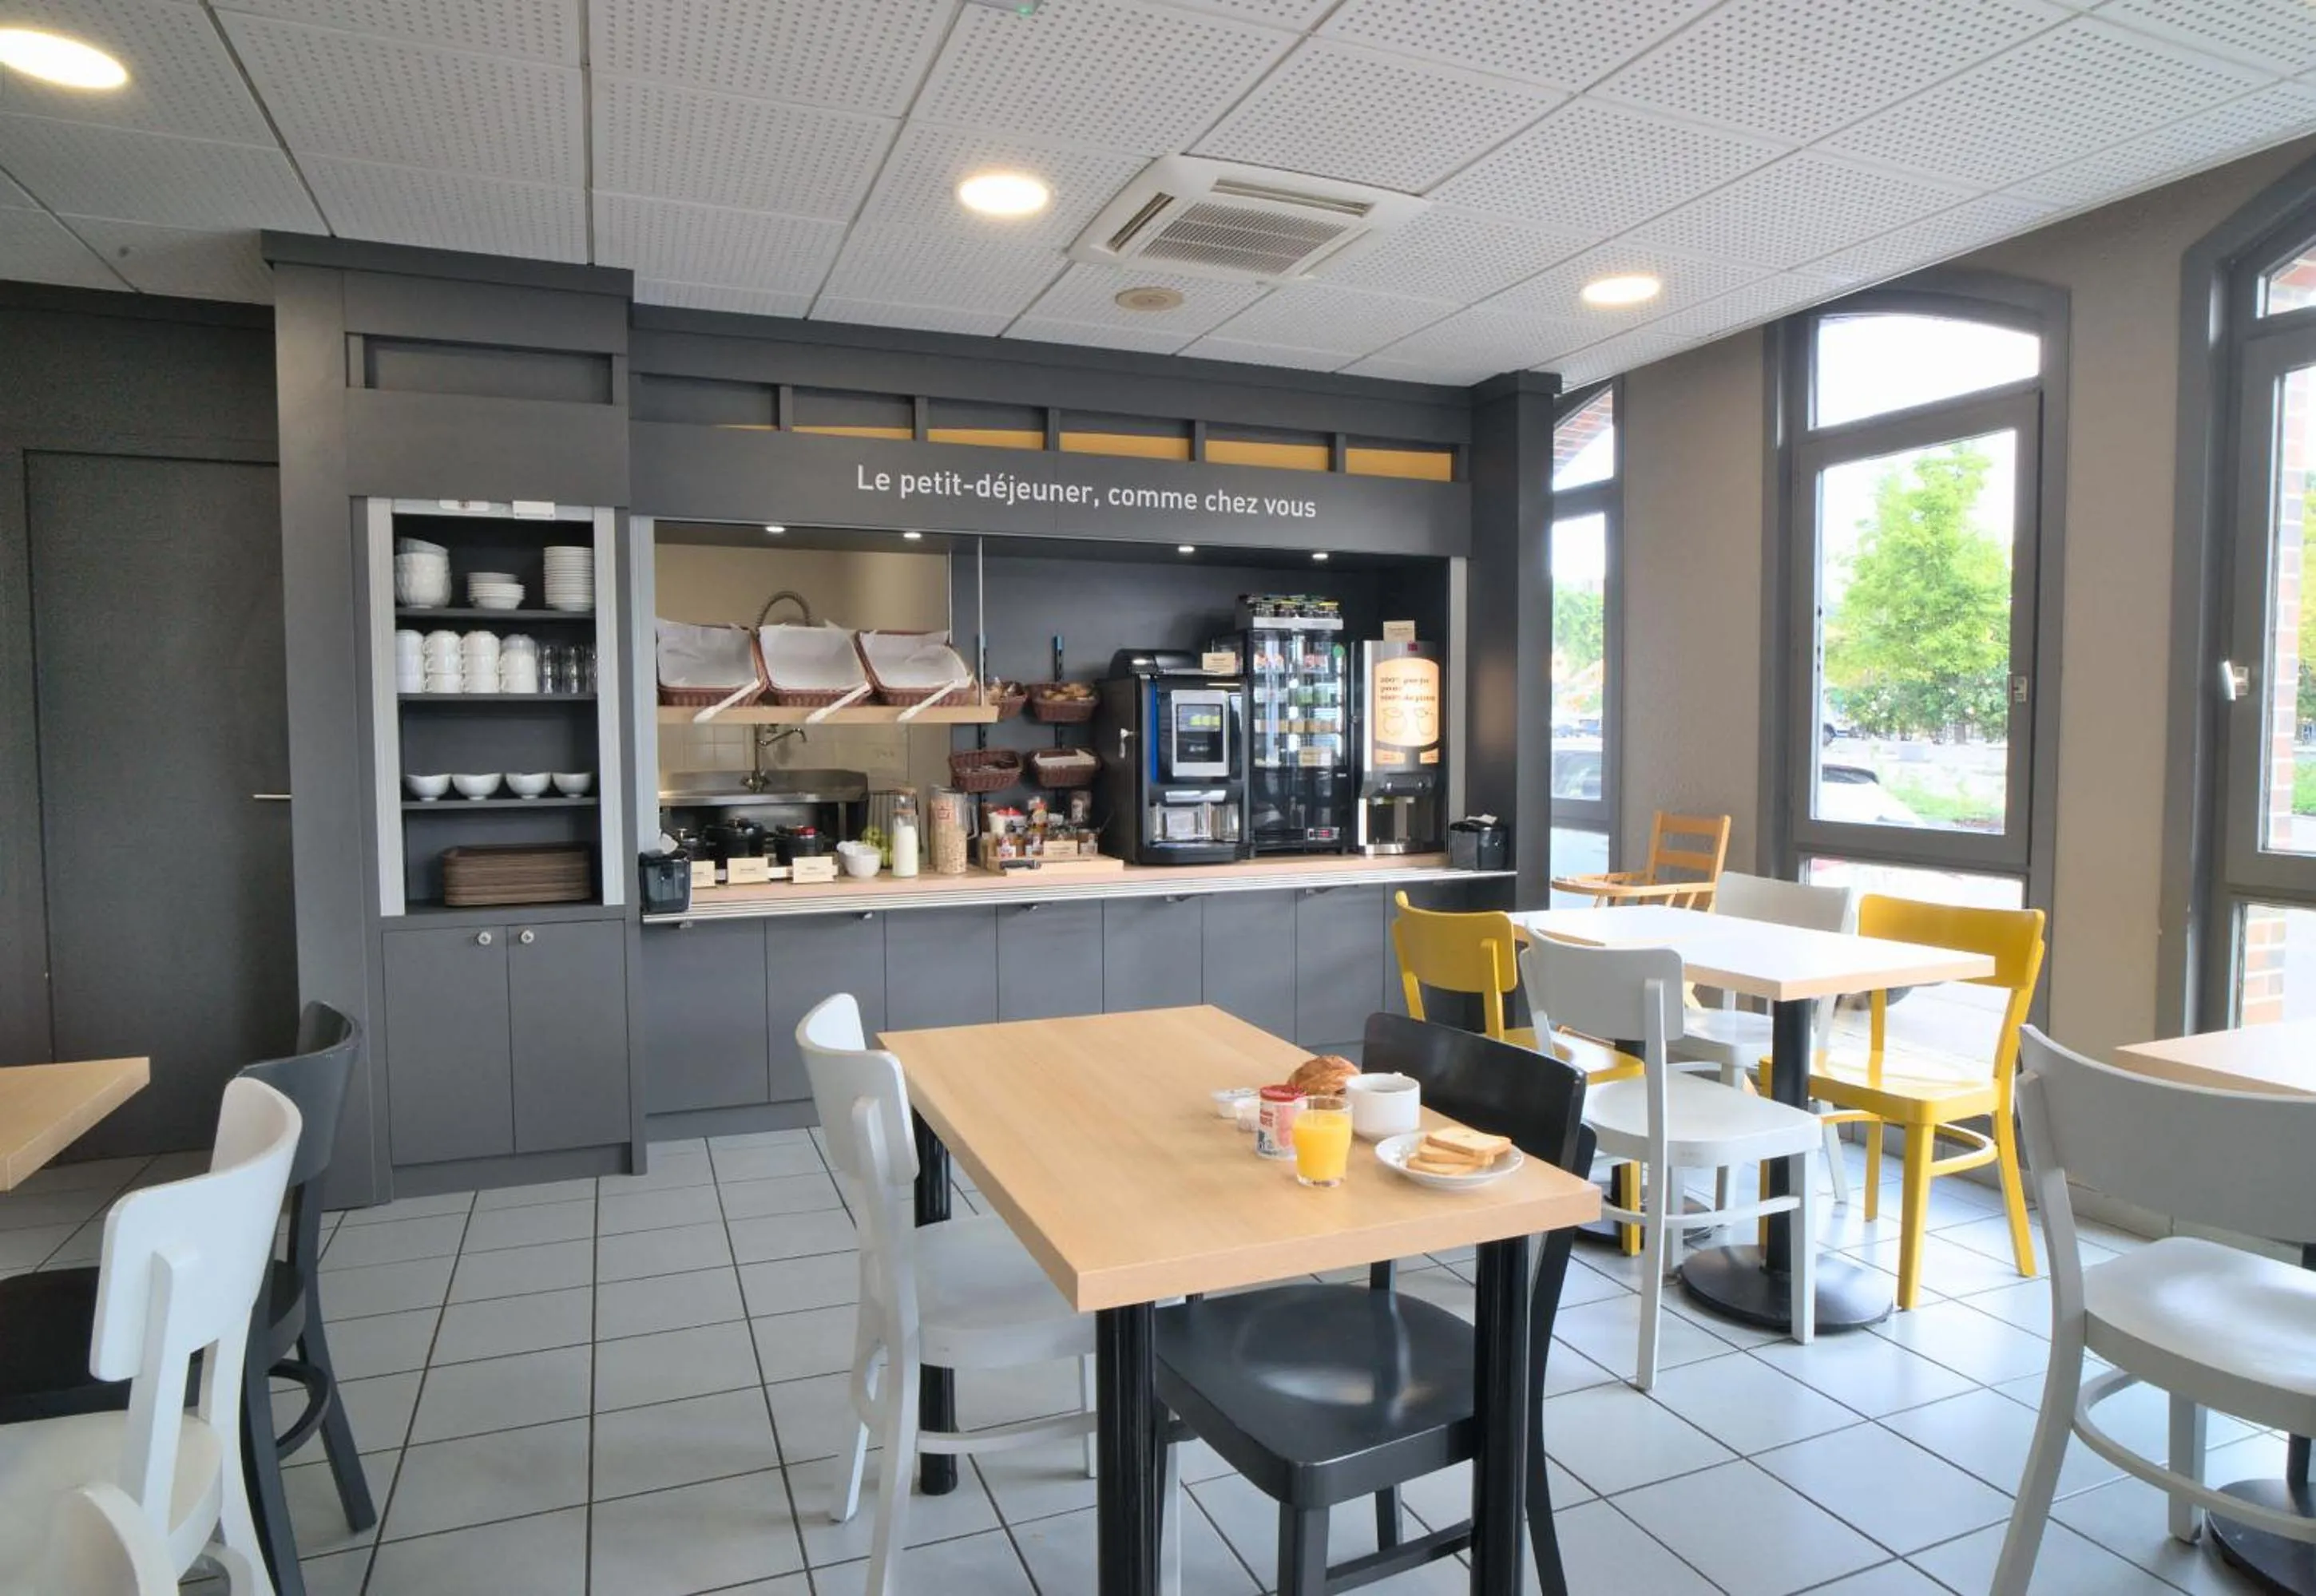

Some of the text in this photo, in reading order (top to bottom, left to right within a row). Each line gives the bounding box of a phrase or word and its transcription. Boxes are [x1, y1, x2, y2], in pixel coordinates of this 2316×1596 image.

[857, 465, 1316, 517] Le petit-déjeuner, comme chez vous
